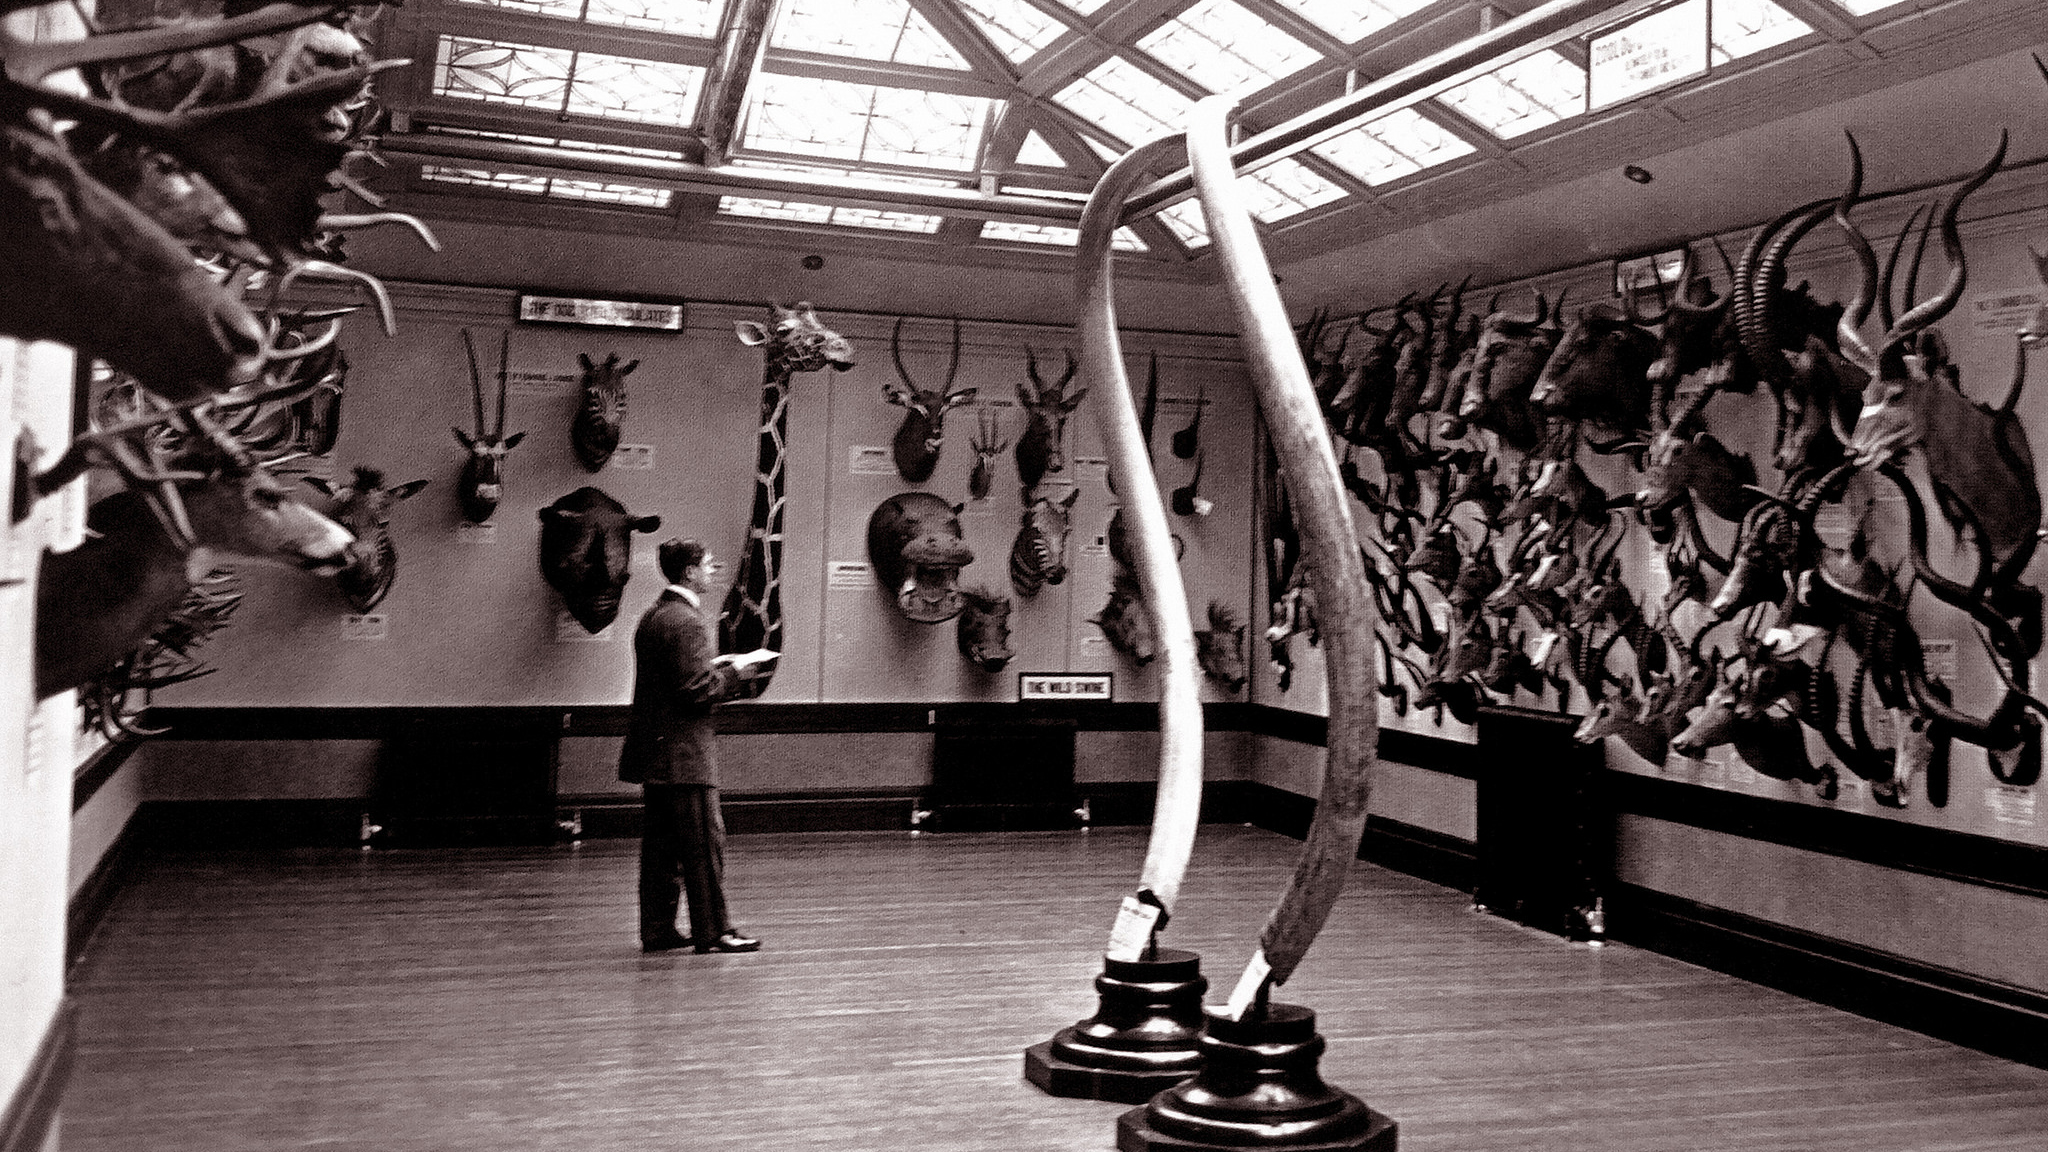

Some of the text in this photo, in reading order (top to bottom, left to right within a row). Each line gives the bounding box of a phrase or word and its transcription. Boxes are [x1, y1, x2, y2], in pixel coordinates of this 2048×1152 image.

[1028, 681, 1105, 694] THE WILD SWINE
